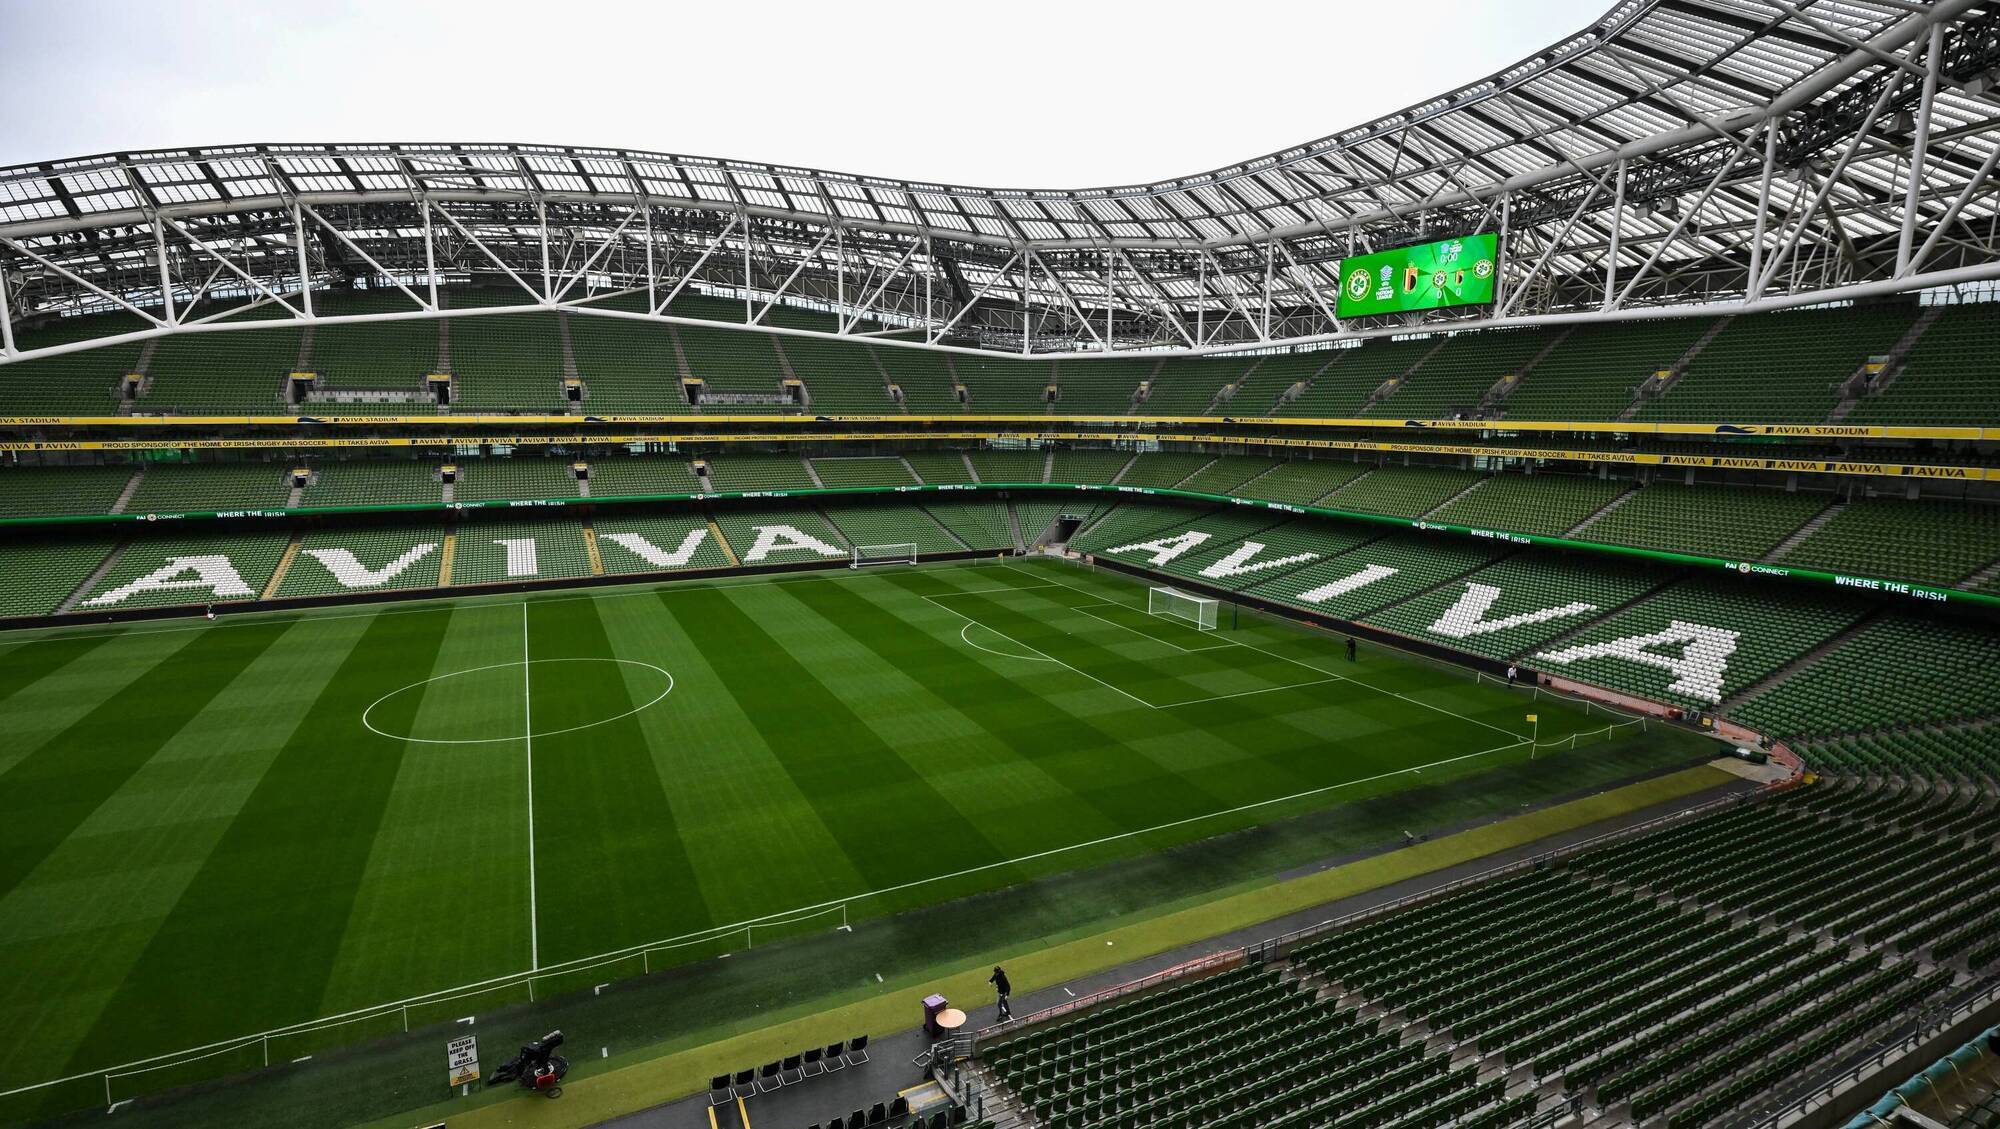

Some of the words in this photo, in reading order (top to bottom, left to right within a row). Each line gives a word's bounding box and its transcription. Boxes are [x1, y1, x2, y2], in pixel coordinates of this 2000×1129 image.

[1455, 287, 1462, 297] 0
[1775, 426, 1811, 434] AVIVA
[1815, 427, 1869, 435] STADIUM
[1611, 454, 1636, 462] AVIVA
[1673, 456, 1706, 465] AVIVA
[1724, 459, 1760, 468] AVIVA
[1777, 461, 1817, 470] AVIVA
[1838, 463, 1882, 473] AVIVA
[1917, 467, 1966, 478] AVIVA
[1426, 523, 1447, 531] CONNECT
[1470, 529, 1494, 538] WHERE
[1496, 531, 1510, 541] THE
[1511, 536, 1531, 545] IRISH
[1725, 562, 1737, 570] FAI
[1751, 566, 1790, 576] CONNECT
[1834, 575, 1880, 590] WHERE
[1883, 582, 1910, 594] THE
[1912, 589, 1947, 602] IRISH
[451, 1039, 472, 1048] PLEASE
[449, 1047, 464, 1056] KEEP
[457, 1051, 469, 1059] THE
[454, 1056, 473, 1066] GRASS
